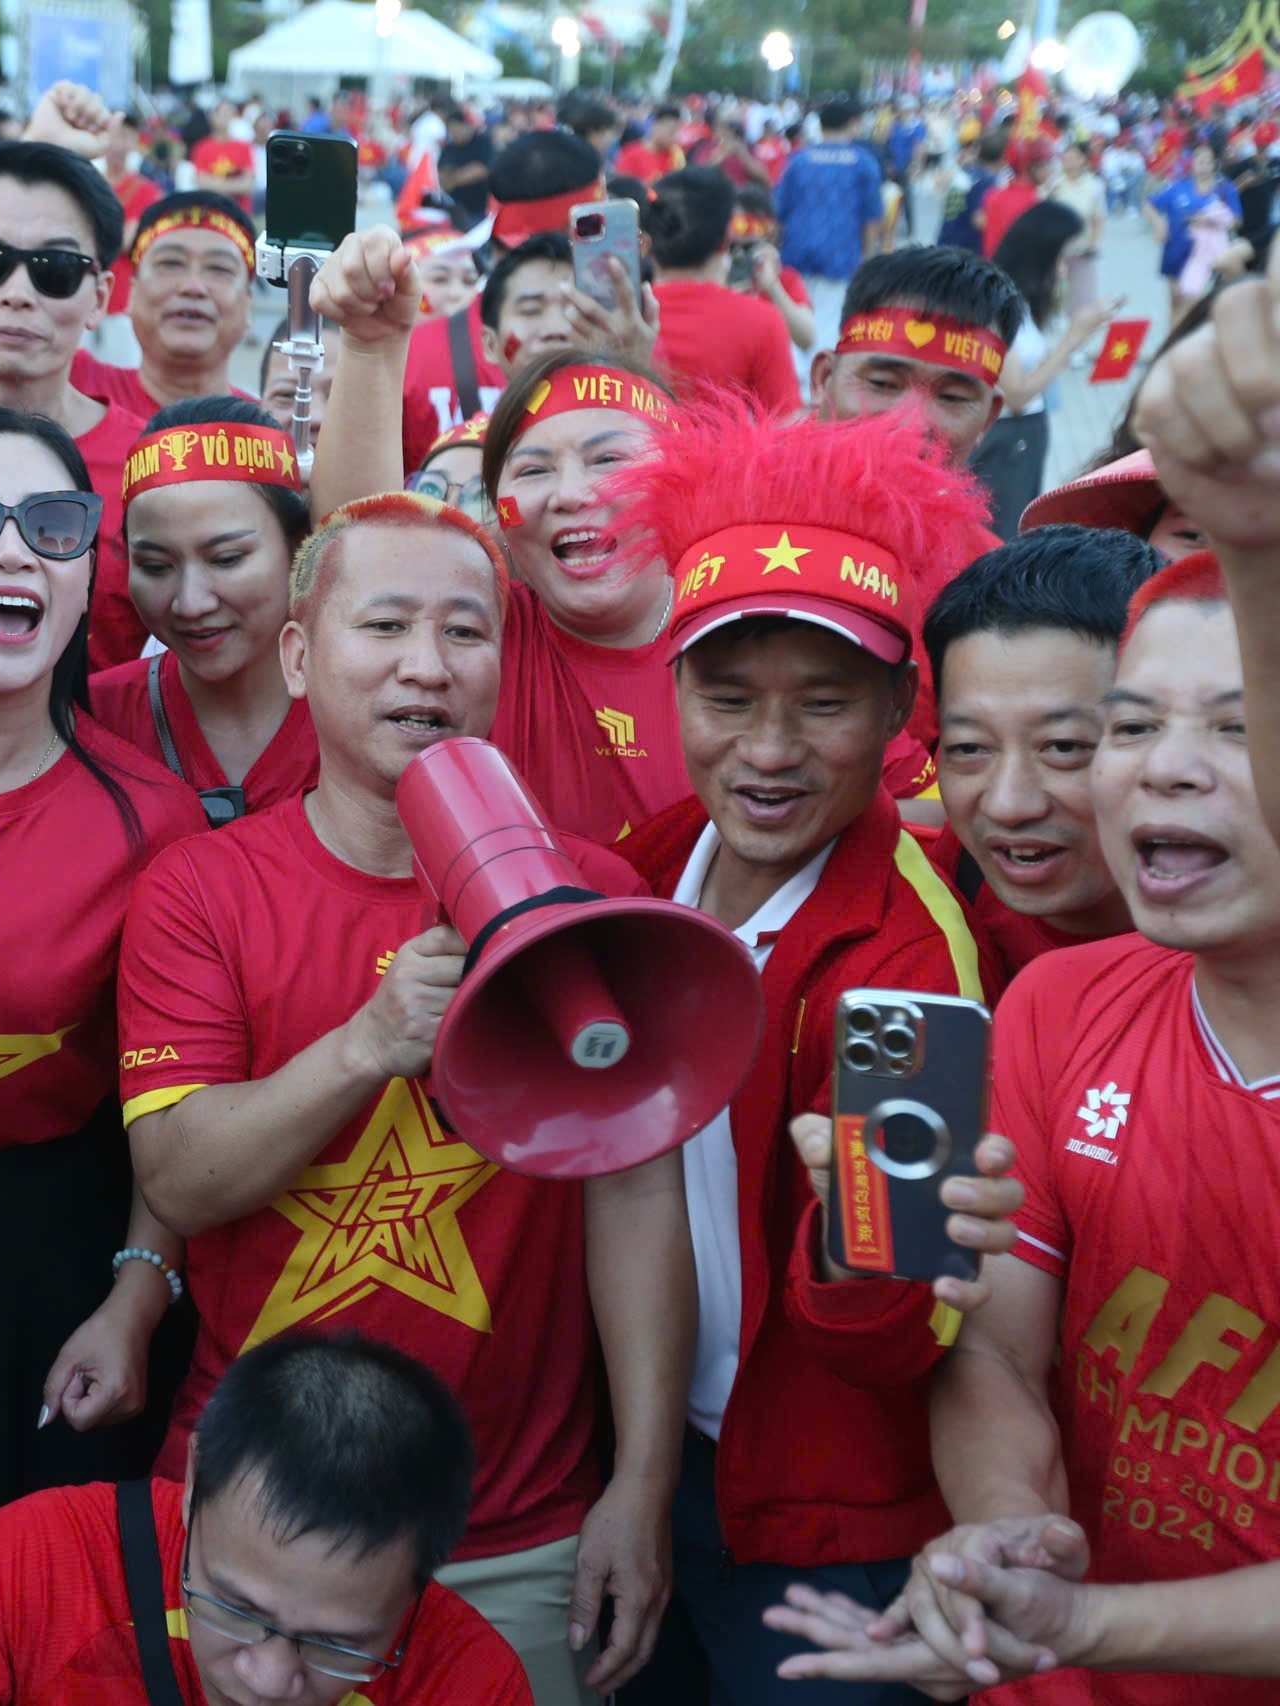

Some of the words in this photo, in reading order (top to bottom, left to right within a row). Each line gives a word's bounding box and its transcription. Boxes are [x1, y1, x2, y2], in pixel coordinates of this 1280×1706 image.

[573, 373, 624, 406] VIỆT
[130, 443, 160, 485] NAM
[201, 428, 230, 467] VÔ
[234, 435, 276, 475] ĐỊCH
[678, 551, 726, 602] VIỆT
[839, 555, 898, 607] NAM
[1103, 1486, 1216, 1551] 2024
